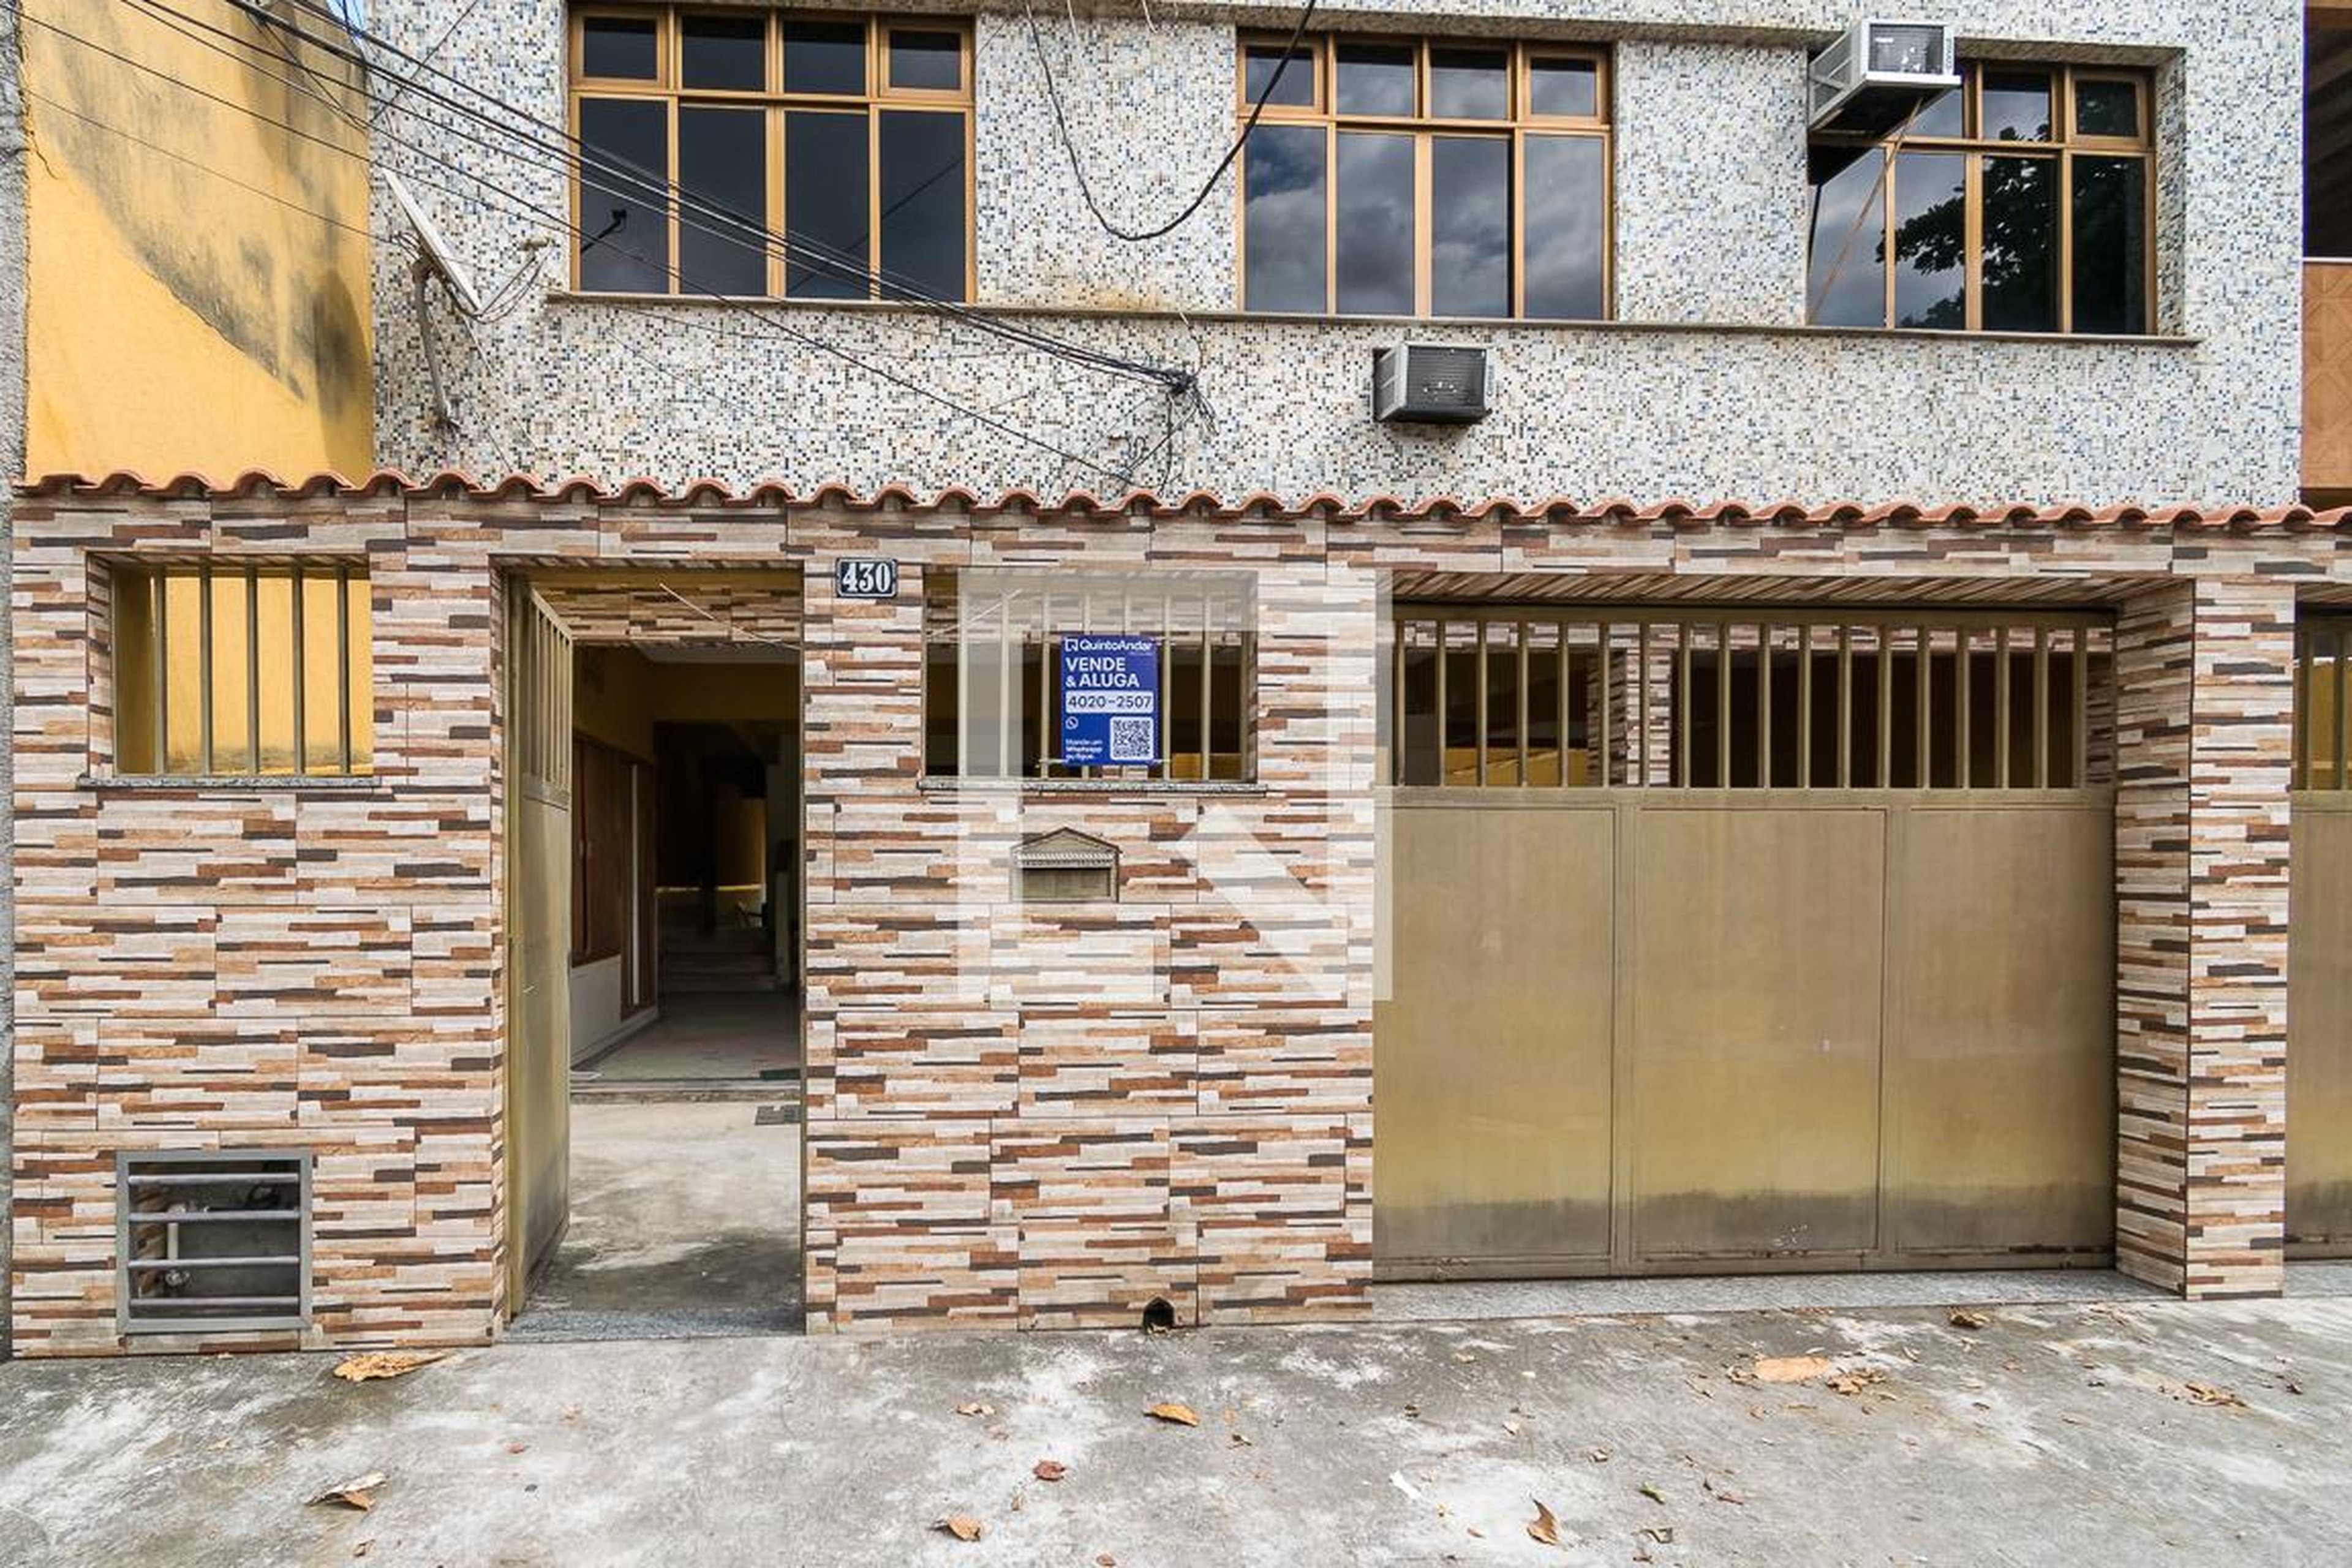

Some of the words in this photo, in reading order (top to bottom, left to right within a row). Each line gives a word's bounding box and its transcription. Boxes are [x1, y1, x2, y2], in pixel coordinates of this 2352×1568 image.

[843, 563, 891, 592] 430
[1079, 639, 1152, 650] QuintoAndar
[1066, 657, 1126, 671] VENDE
[1065, 675, 1076, 687] &
[1079, 674, 1140, 687] ALUGA
[1068, 695, 1152, 708] 4020-2507
